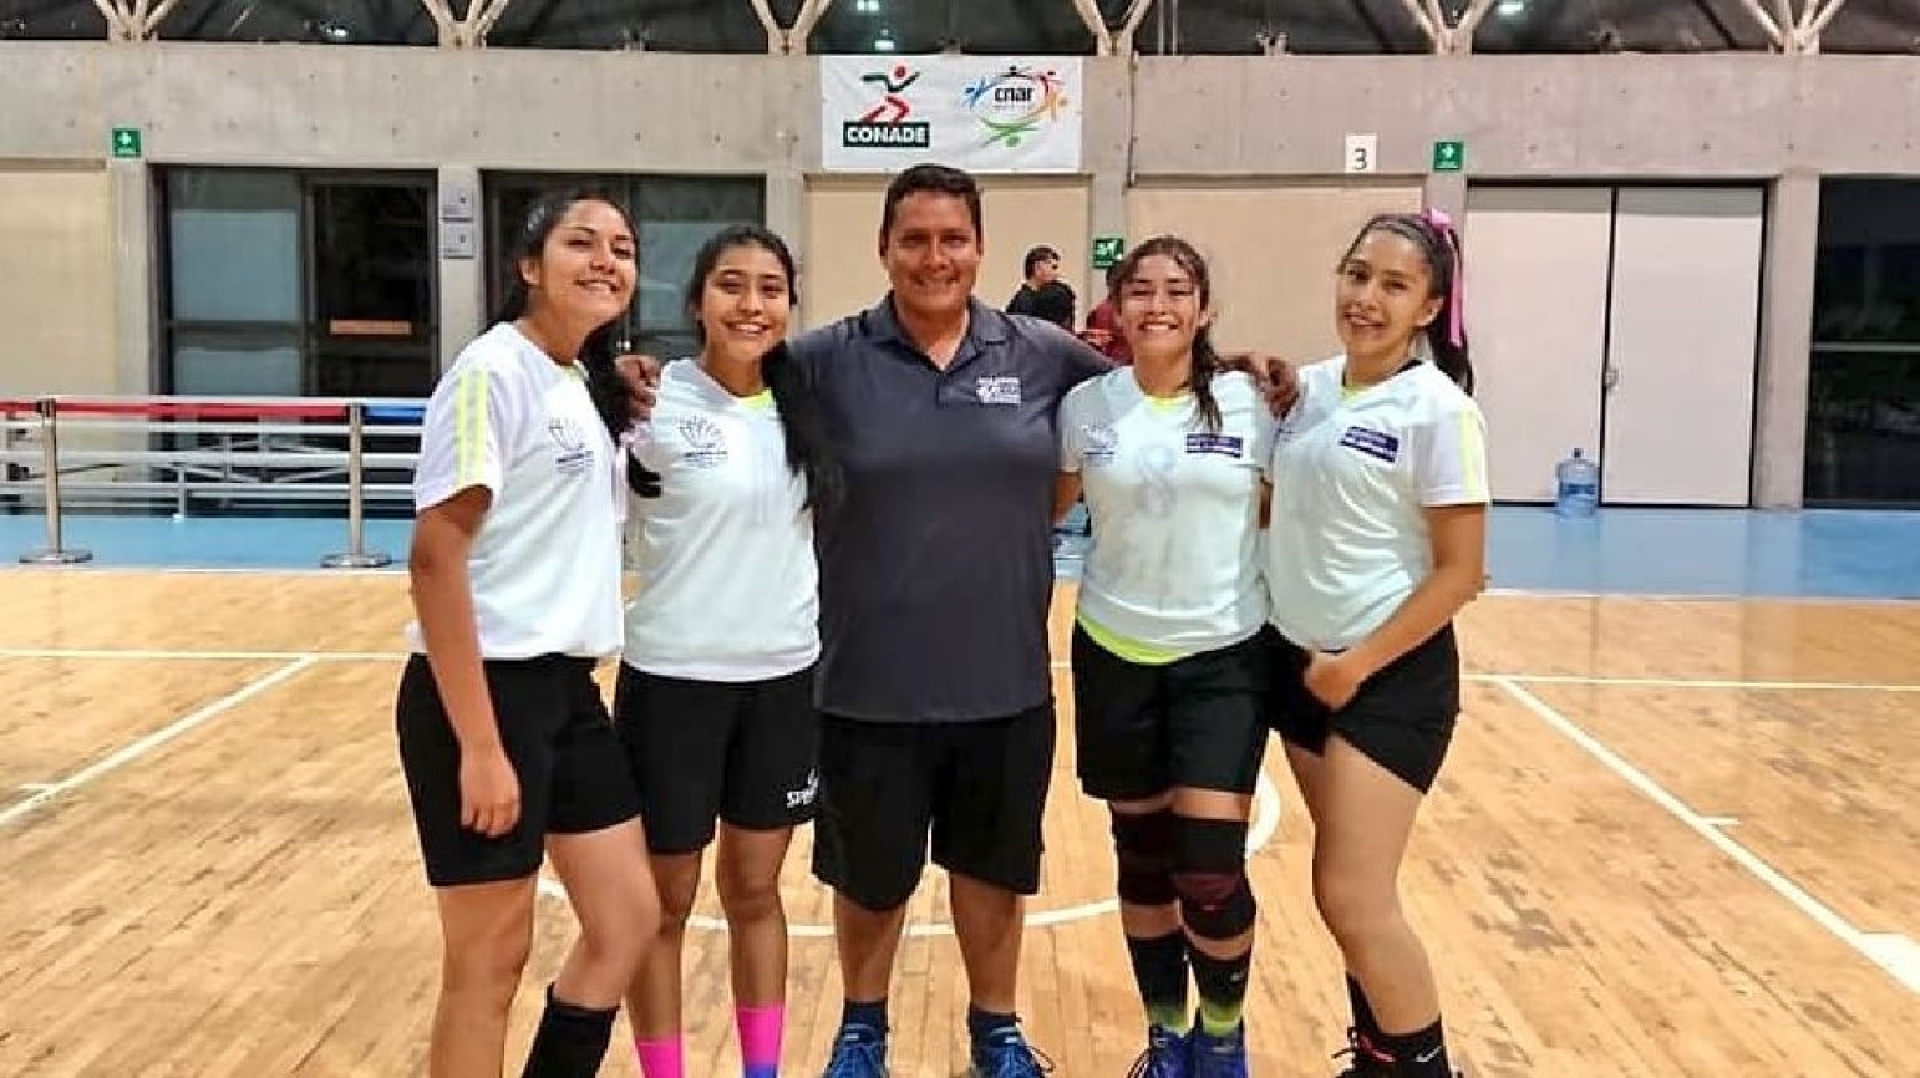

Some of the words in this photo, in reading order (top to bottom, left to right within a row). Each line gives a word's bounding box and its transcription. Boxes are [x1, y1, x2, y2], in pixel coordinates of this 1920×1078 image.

[994, 87, 1035, 102] cnar
[847, 126, 926, 143] CONADE
[1354, 148, 1367, 170] 3
